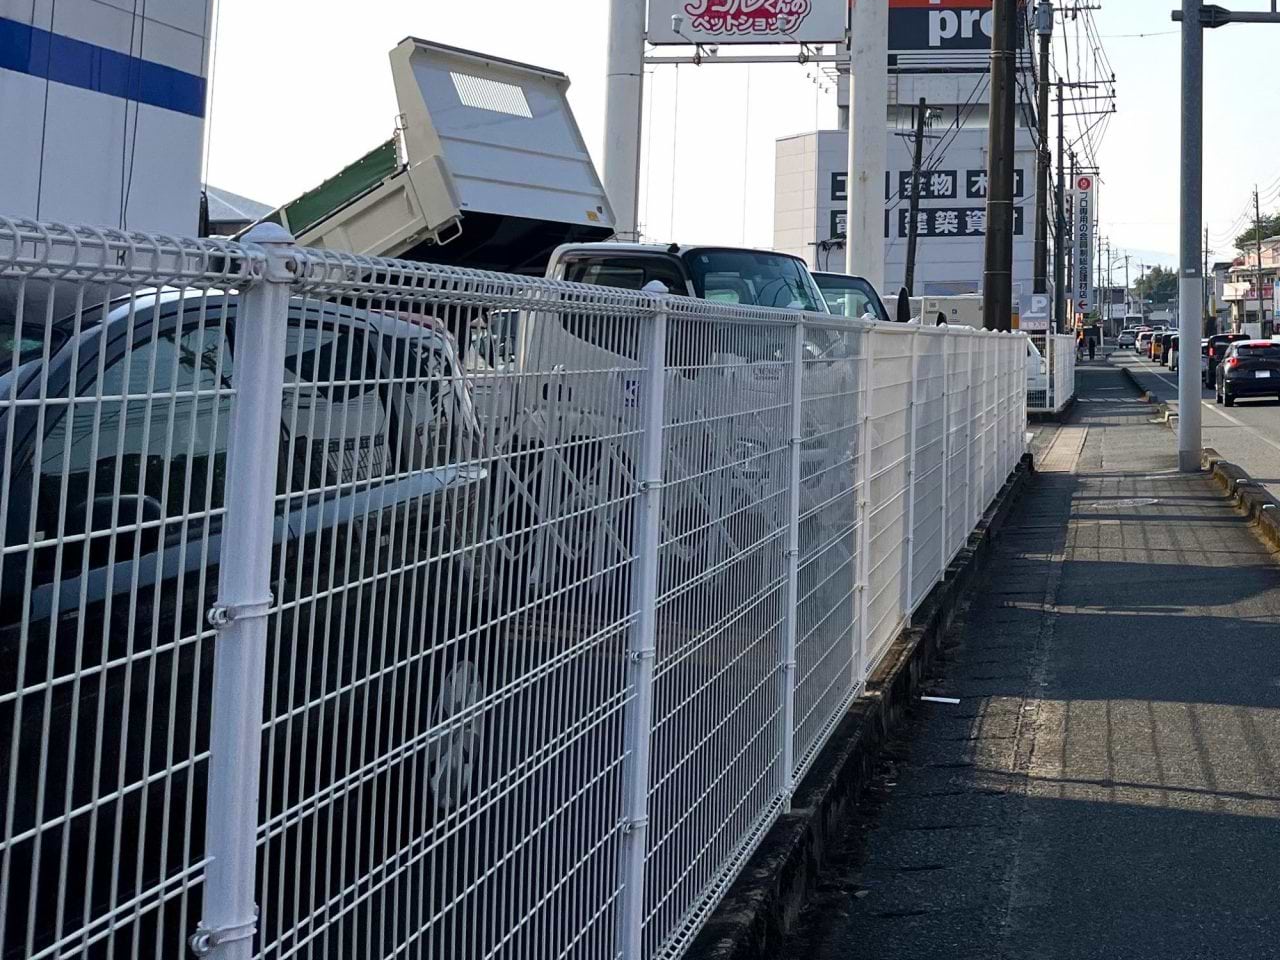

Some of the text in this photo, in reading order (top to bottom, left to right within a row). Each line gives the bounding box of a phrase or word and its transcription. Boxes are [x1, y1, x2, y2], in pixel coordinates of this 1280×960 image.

[691, 13, 801, 33] ペットショップ
[904, 210, 1018, 234] 建築資
[1032, 296, 1047, 312] P
